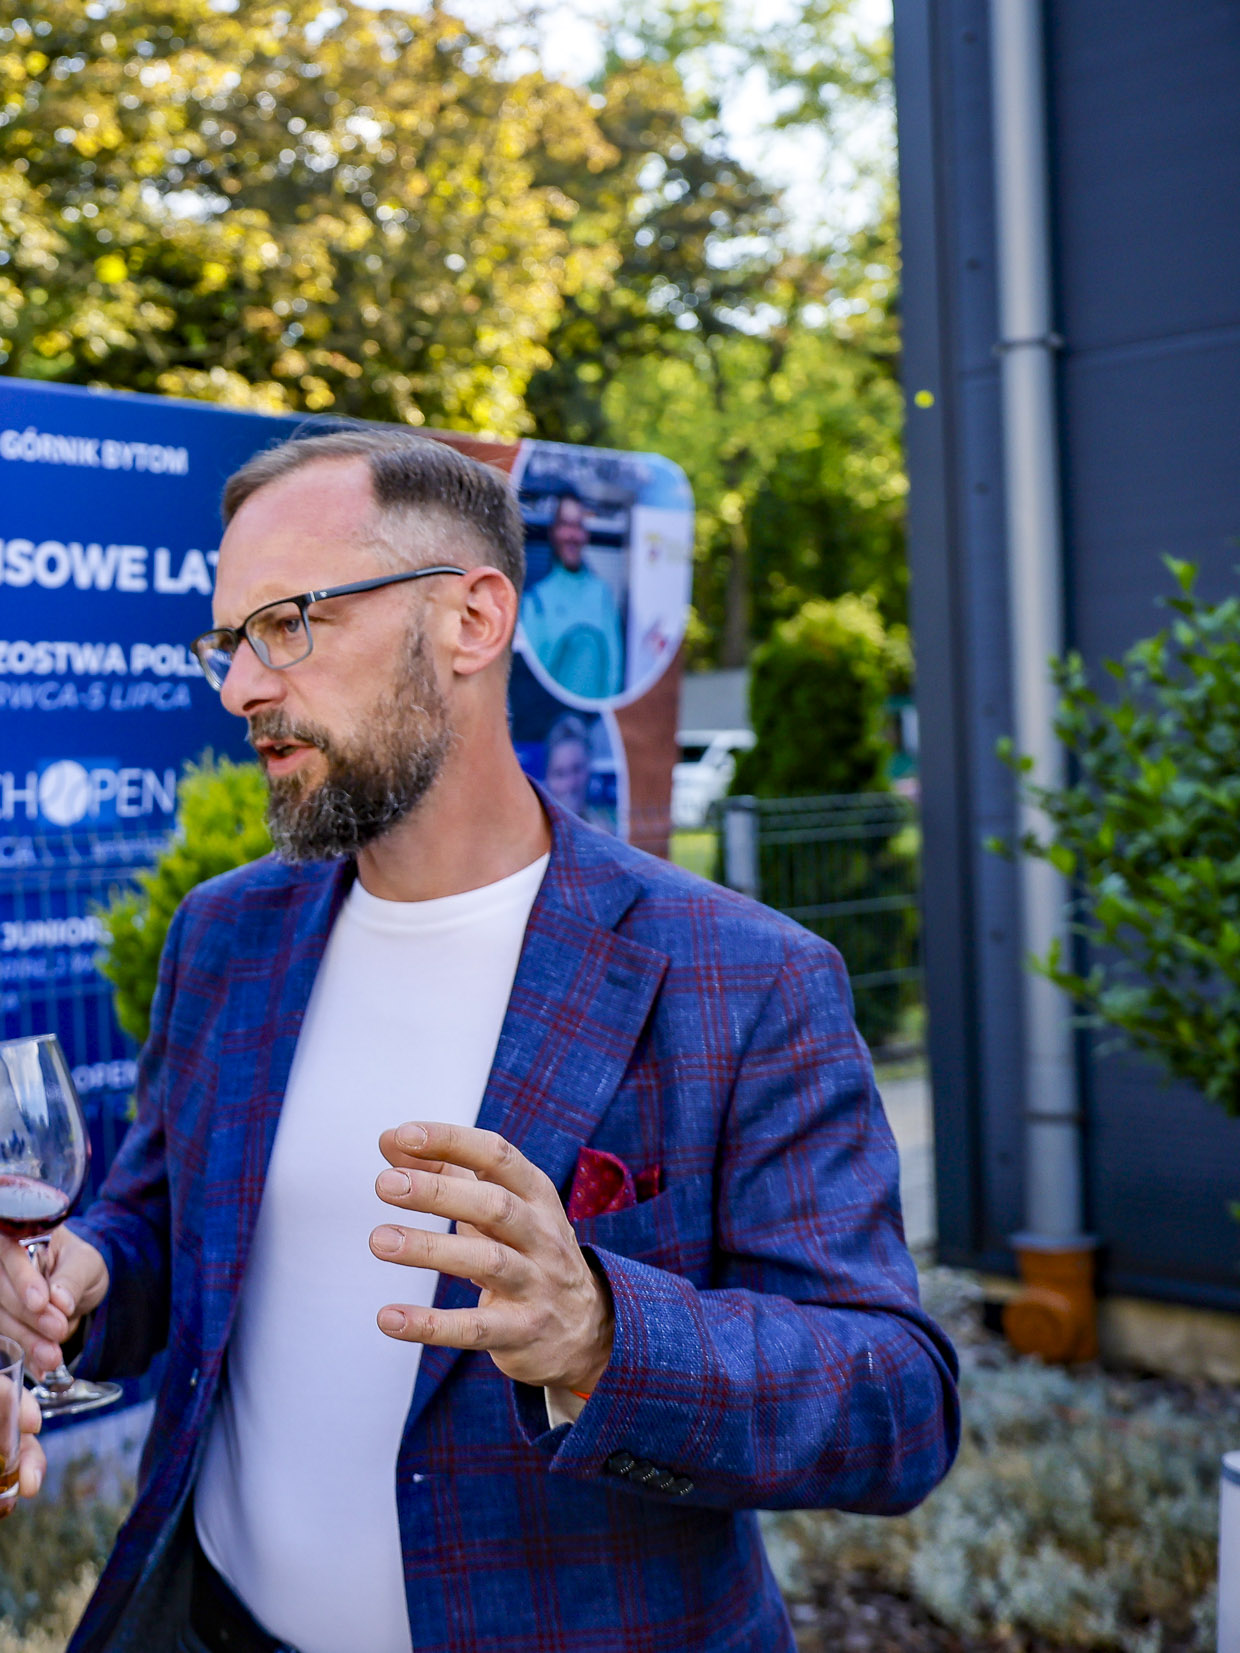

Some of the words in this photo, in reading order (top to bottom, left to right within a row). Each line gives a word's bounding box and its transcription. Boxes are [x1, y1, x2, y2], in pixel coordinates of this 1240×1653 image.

[0, 426, 100, 468] GÓRNIK
[101, 439, 189, 476] BYTOM
[109, 682, 192, 711] LIPCA
